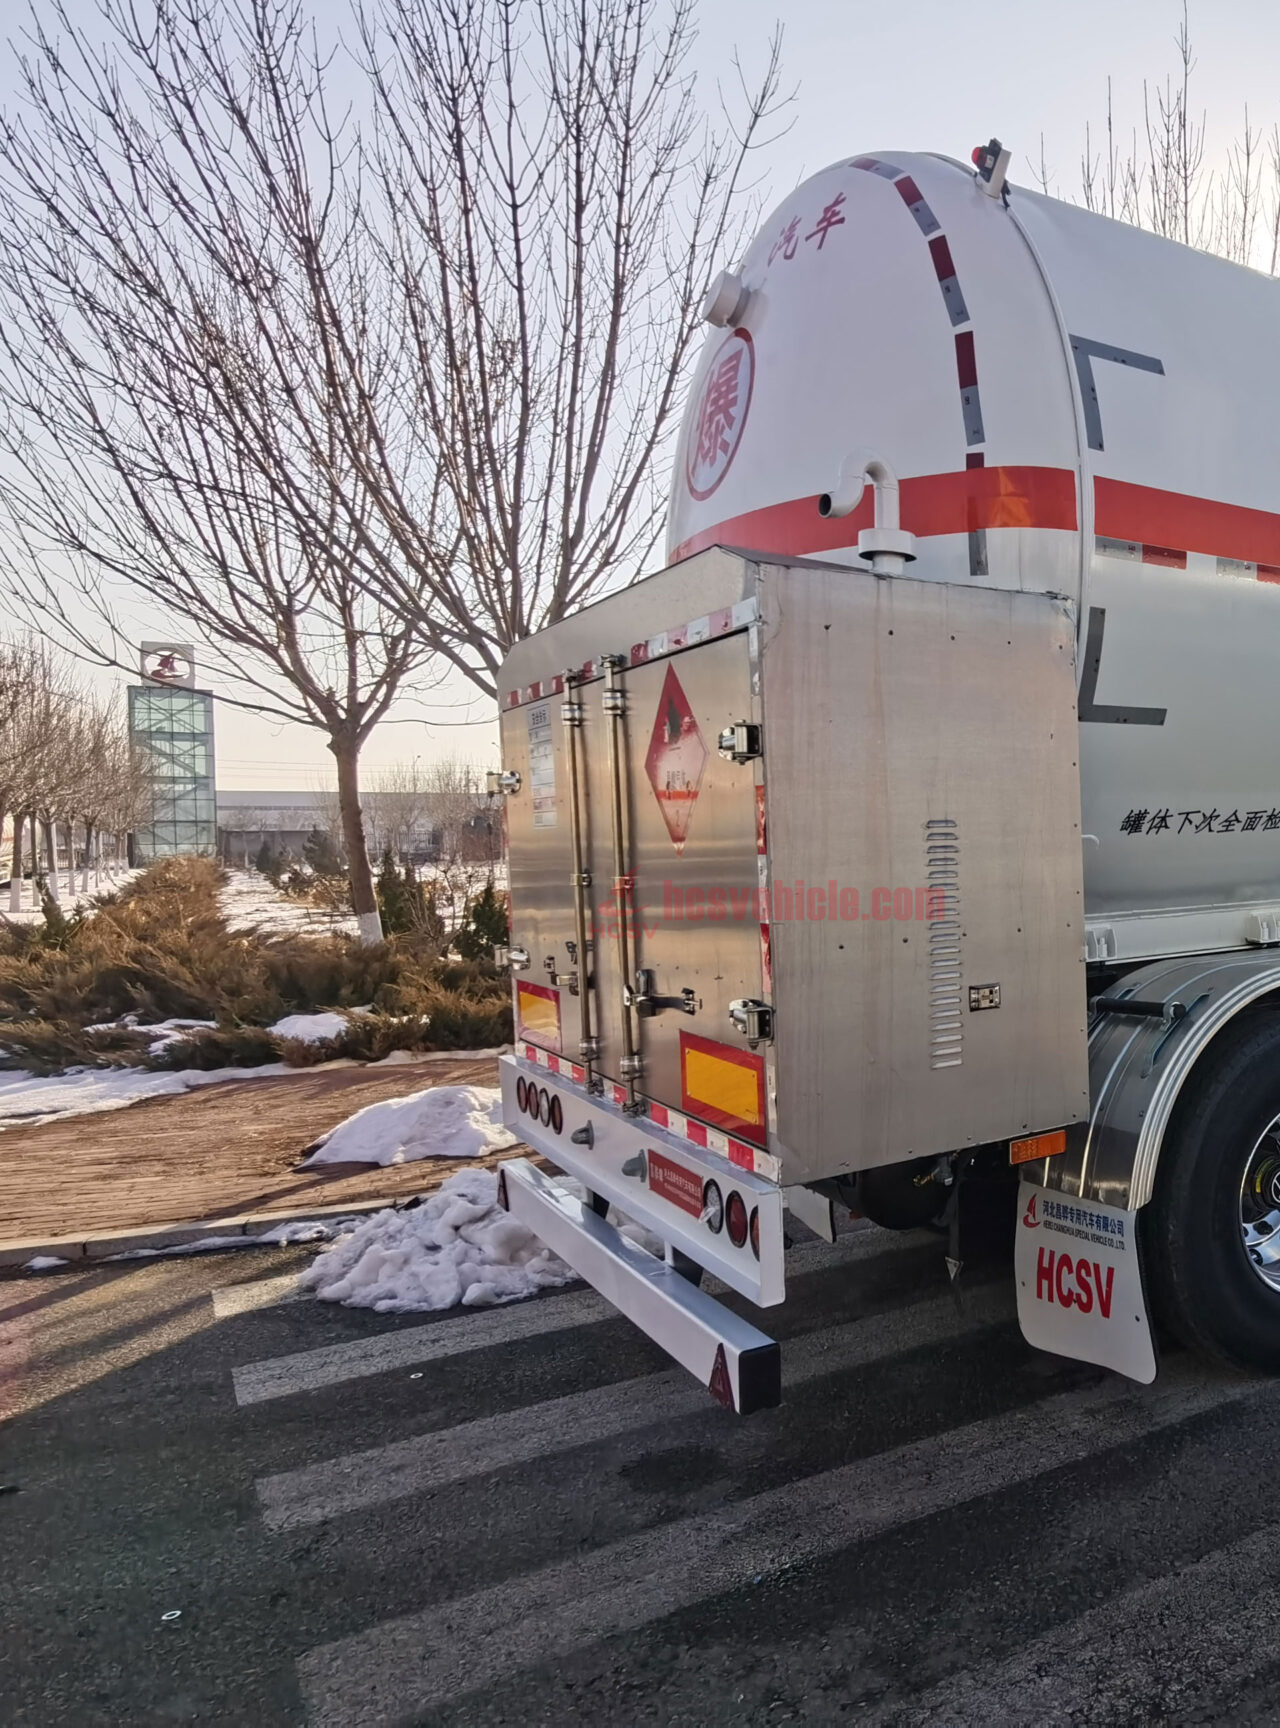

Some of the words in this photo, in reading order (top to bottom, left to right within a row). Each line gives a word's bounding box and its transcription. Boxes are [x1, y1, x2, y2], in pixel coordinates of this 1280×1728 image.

[692, 347, 743, 477] 爆
[1043, 1200, 1125, 1238] 河北昌骅专用汽车有限公司
[1074, 1227, 1090, 1242] SPECIAL
[1090, 1232, 1107, 1247] VEHICLE
[1036, 1246, 1115, 1319] HCSV
